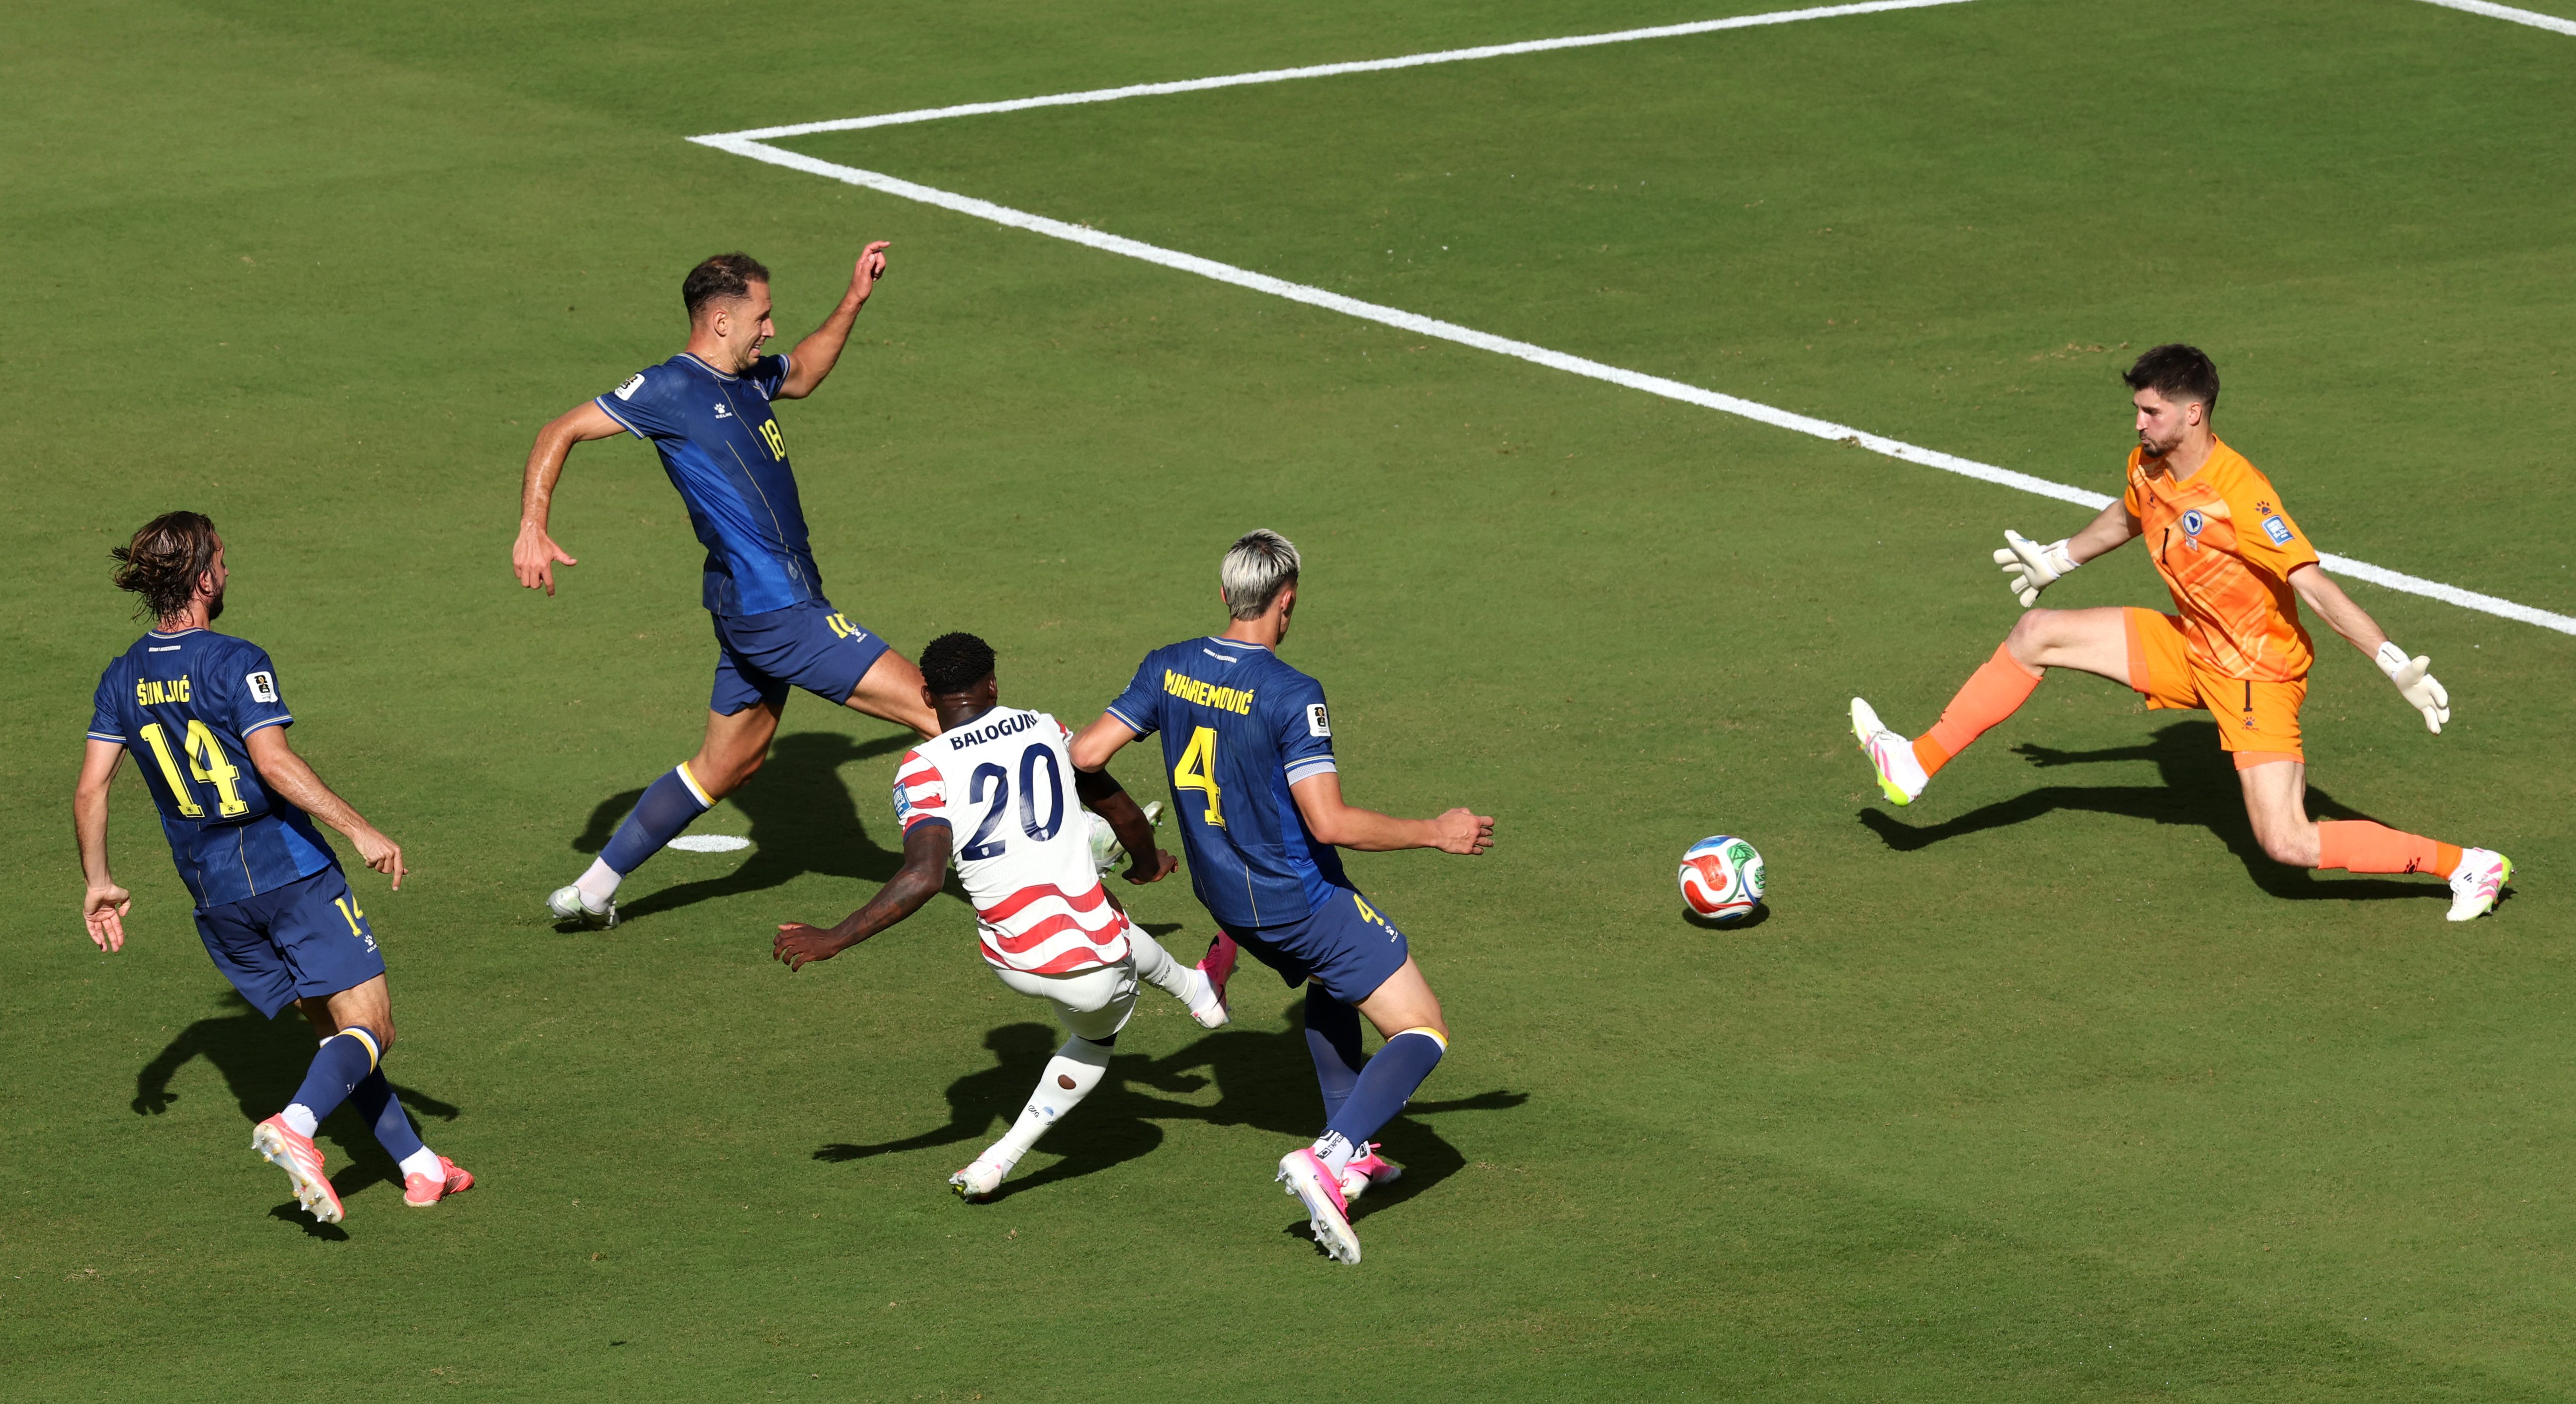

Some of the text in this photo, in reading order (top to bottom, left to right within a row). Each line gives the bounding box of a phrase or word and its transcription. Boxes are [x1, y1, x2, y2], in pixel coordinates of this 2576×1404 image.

[758, 418, 785, 462] 18
[2162, 528, 2169, 565] 1
[137, 674, 189, 706] ŠUNJIĆ
[2244, 680, 2252, 712] 1
[949, 714, 1037, 750] BALOGUN
[140, 720, 249, 818] 14
[1174, 726, 1227, 831] 4
[961, 743, 1064, 861] 20
[1353, 894, 1385, 926] 4
